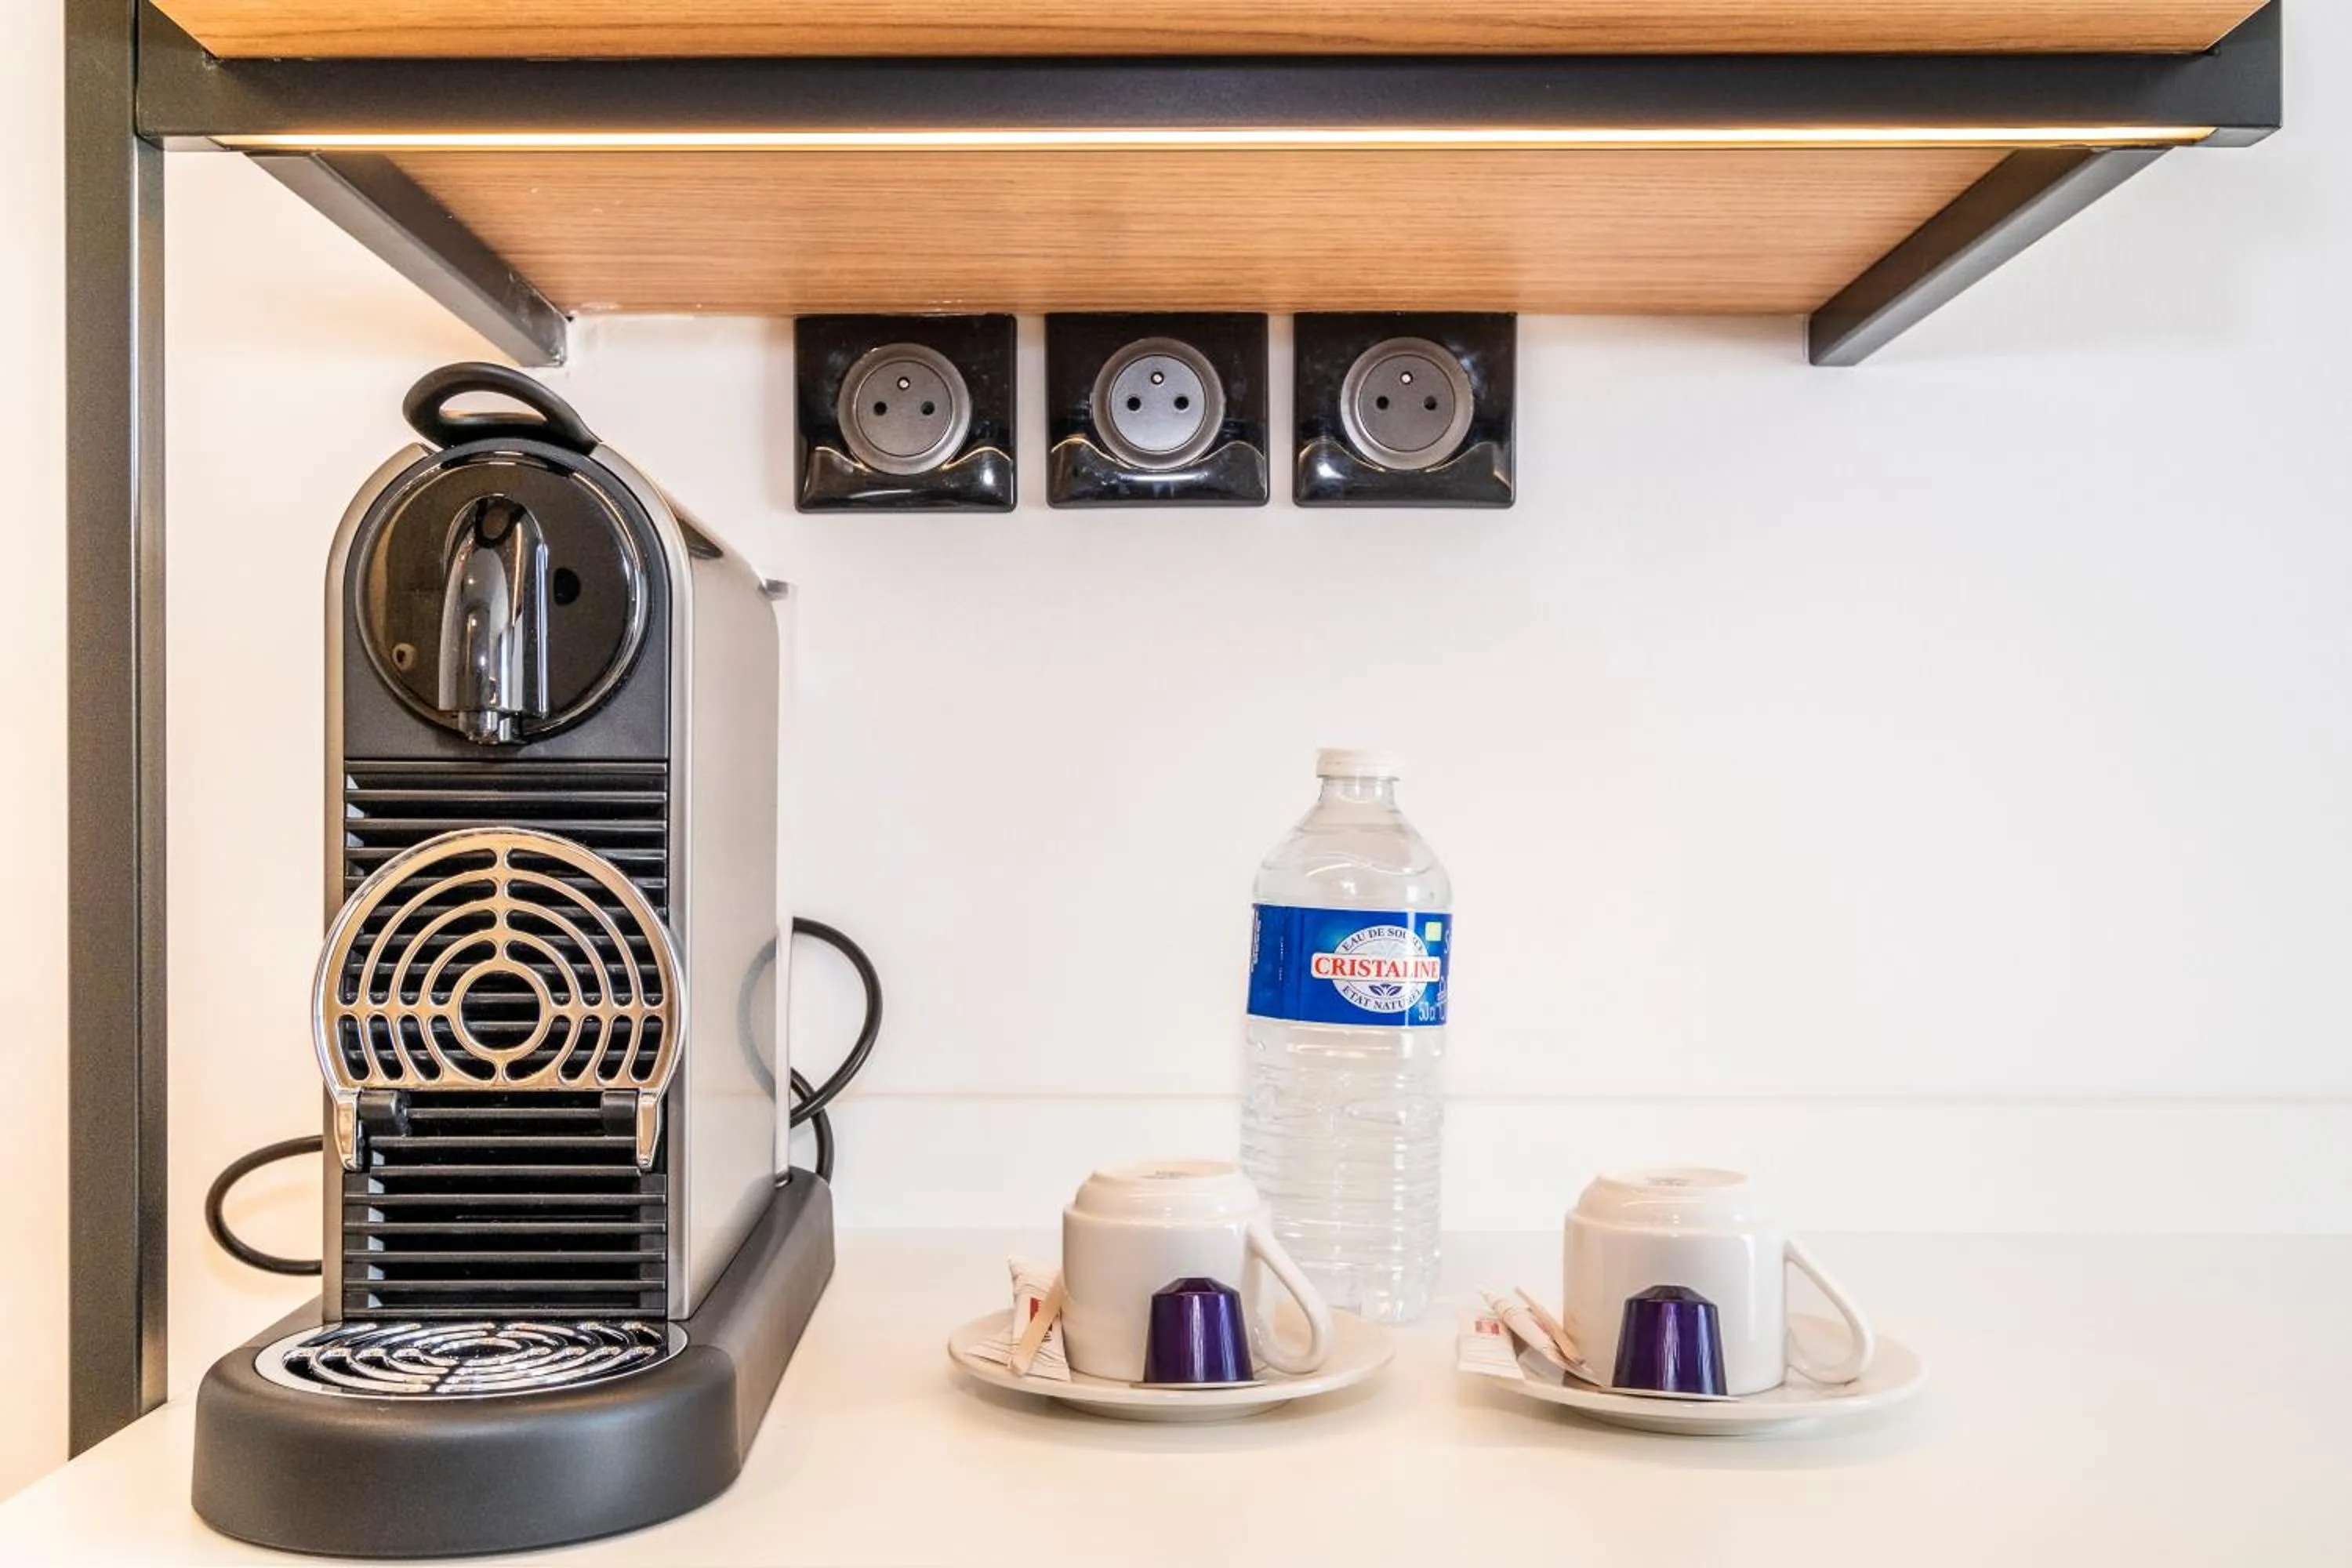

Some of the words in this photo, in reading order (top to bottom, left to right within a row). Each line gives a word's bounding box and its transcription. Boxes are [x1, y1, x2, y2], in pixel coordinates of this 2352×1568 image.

[1341, 931, 1367, 951] EAU
[1368, 927, 1385, 939] DE
[1315, 956, 1439, 978] CRISTALINE
[1342, 985, 1371, 1007] ETAT
